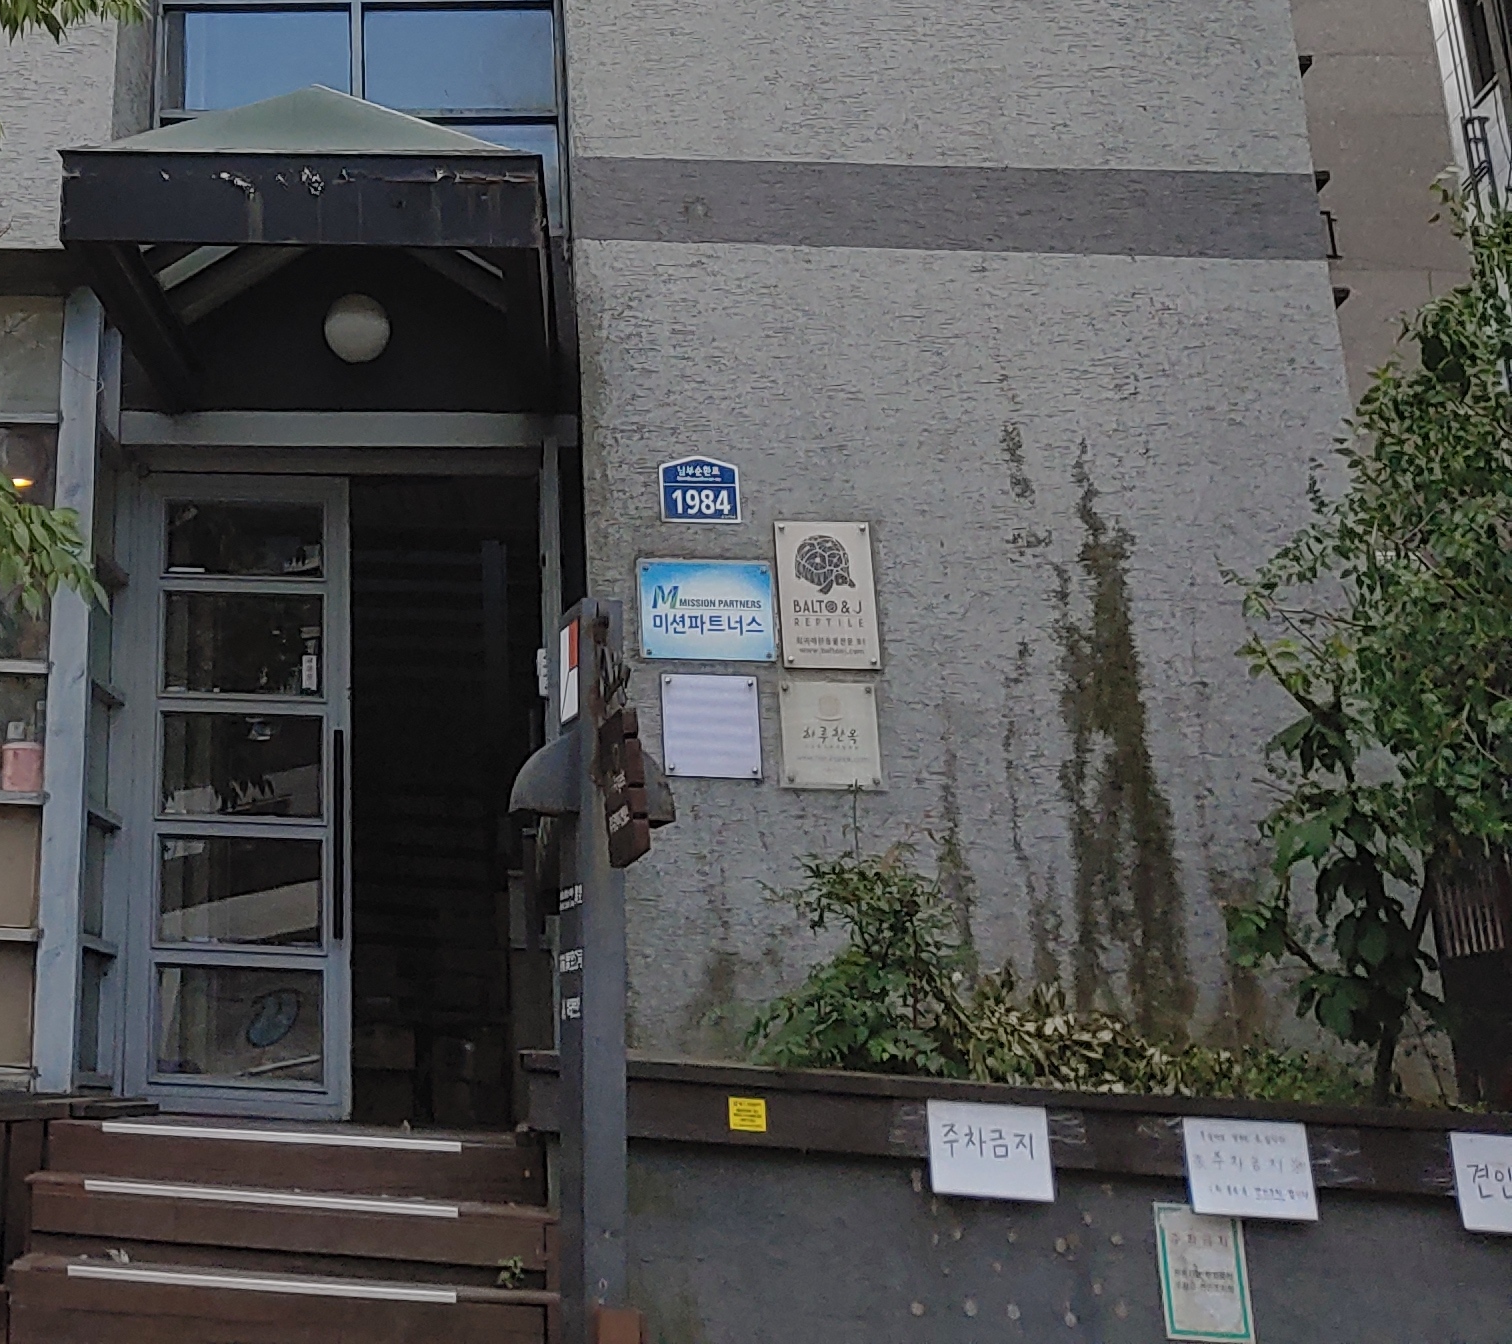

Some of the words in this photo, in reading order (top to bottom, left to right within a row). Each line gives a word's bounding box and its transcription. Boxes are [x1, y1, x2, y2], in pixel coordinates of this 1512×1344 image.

[671, 489, 731, 515] 1984
[679, 598, 716, 608] MISSION
[718, 599, 762, 610] PARTNERS
[793, 599, 838, 614] BALTO
[841, 600, 850, 614] &
[852, 600, 862, 614] J
[652, 613, 765, 636] 미션파트너스
[794, 618, 865, 628] REPTILE
[941, 1123, 1034, 1161] 주차금지
